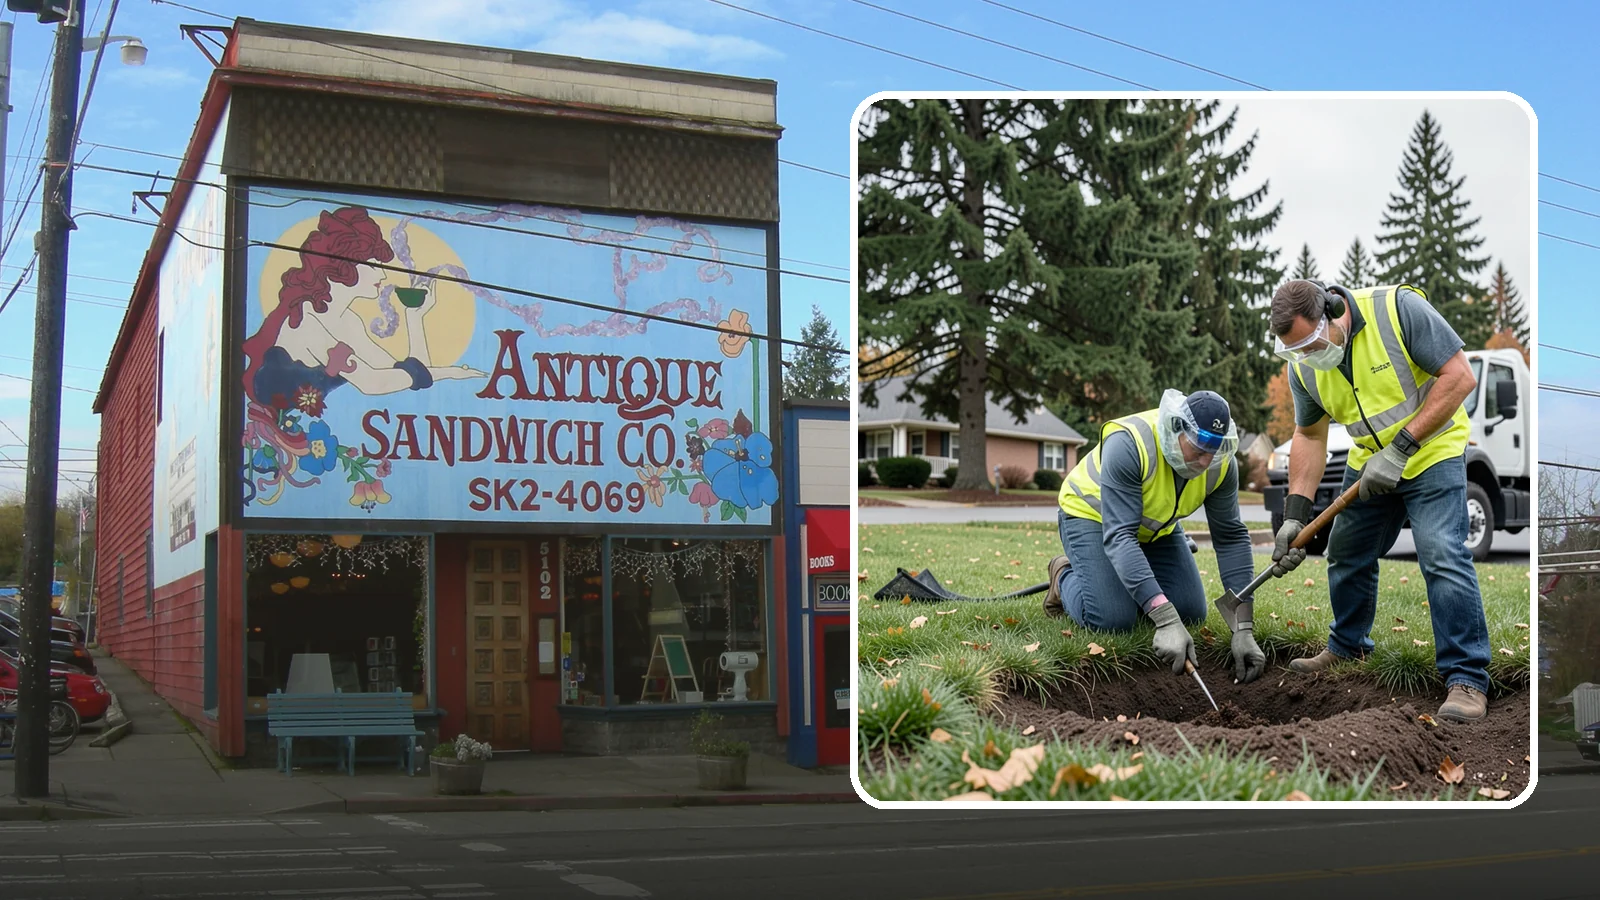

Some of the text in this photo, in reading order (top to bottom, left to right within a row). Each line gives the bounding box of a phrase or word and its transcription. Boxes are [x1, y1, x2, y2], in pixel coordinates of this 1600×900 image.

[475, 329, 723, 421] ANTIQUE
[361, 408, 685, 469] SANDWICH CO.
[468, 477, 645, 514] SK2-4069
[540, 541, 551, 600] 5102
[809, 555, 835, 569] BOOKS
